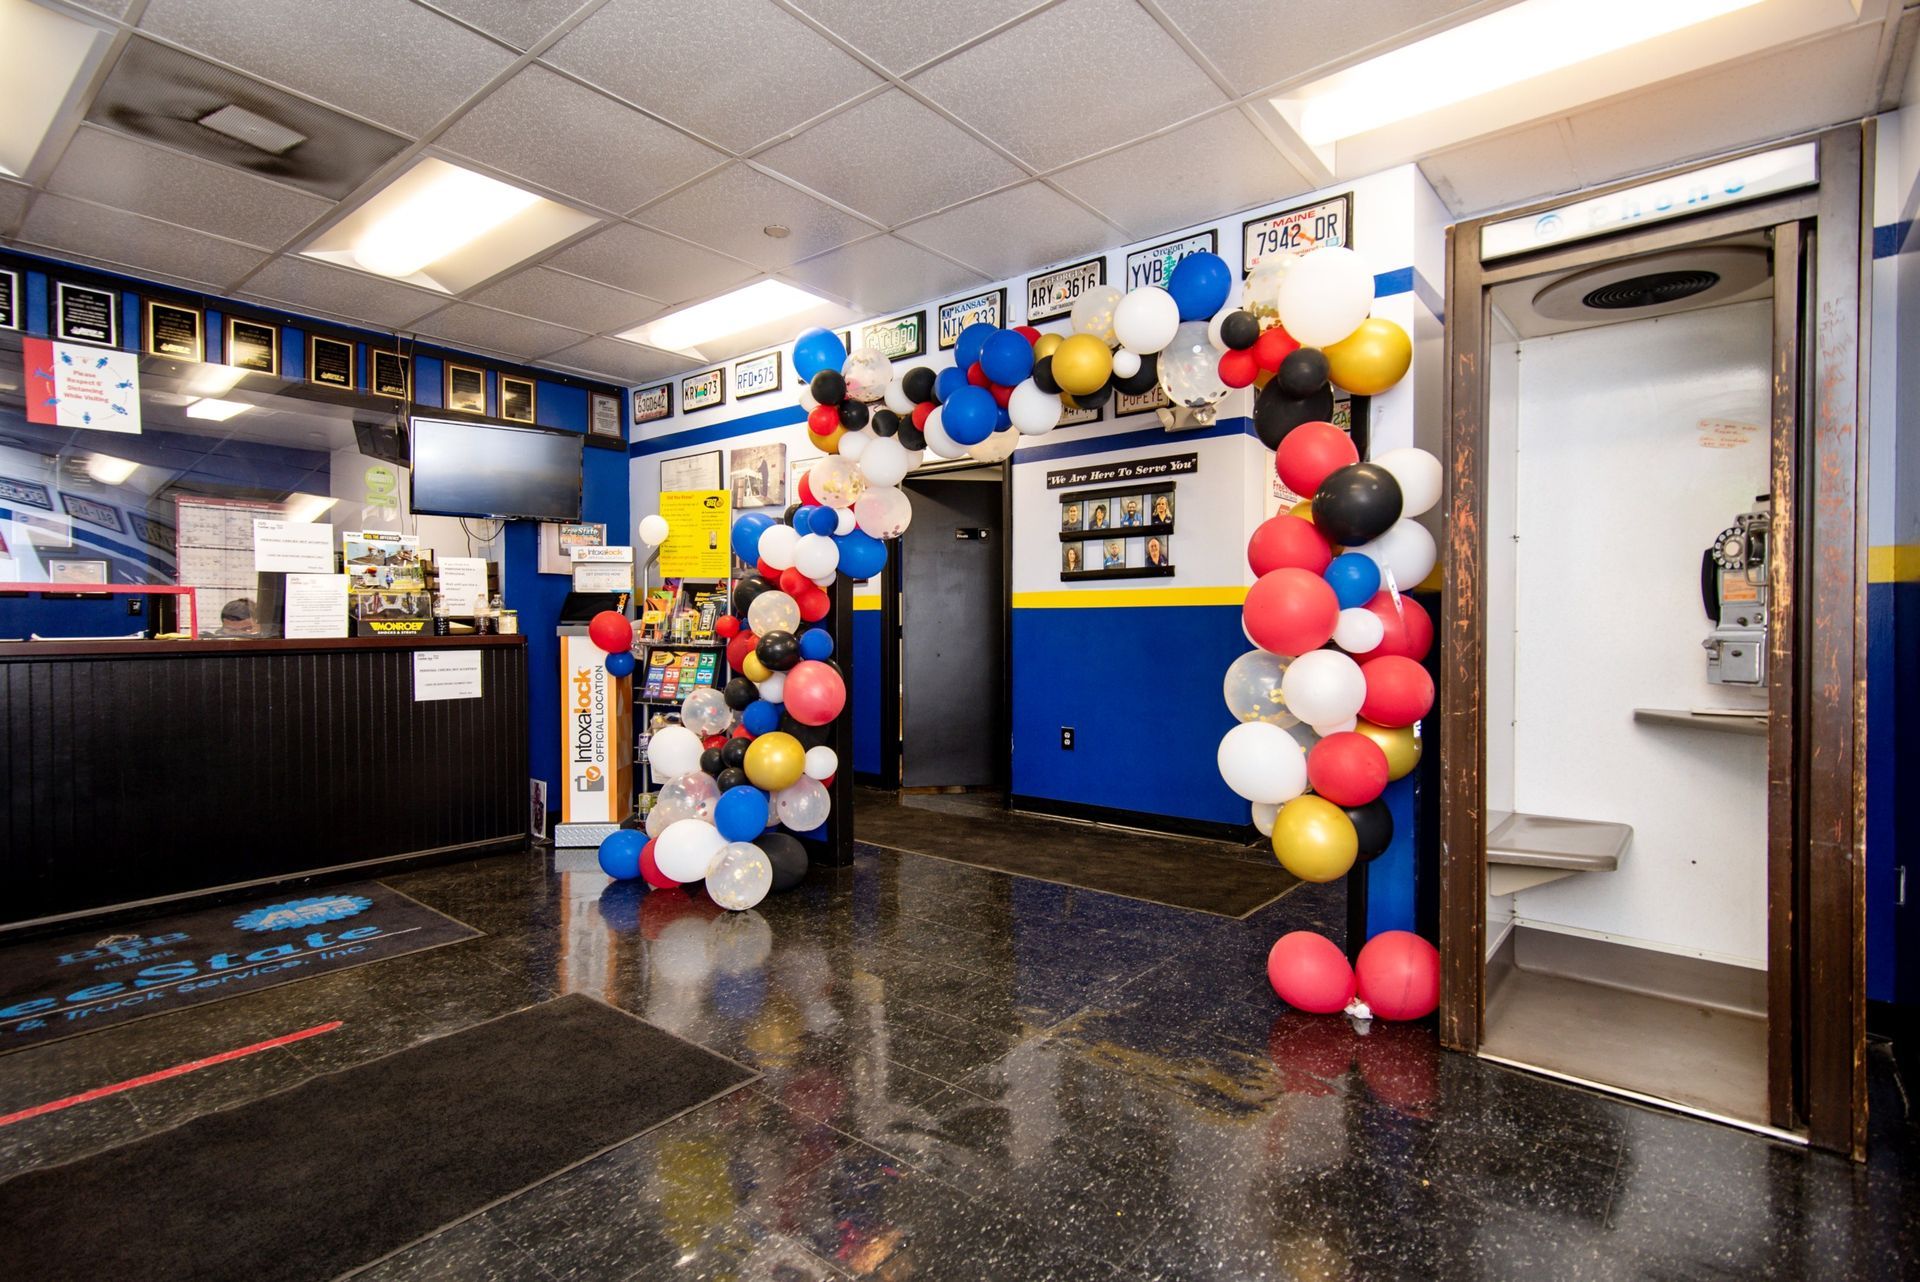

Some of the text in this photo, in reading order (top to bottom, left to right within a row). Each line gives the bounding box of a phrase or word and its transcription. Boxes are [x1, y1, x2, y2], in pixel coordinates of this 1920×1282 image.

[1272, 210, 1316, 228] MAINE
[1257, 213, 1338, 256] 7942 DR
[1152, 243, 1184, 257] Oregon
[1045, 270, 1086, 284] GEORGIA
[1132, 259, 1163, 288] YVB
[1031, 273, 1096, 308] ARY 3616
[955, 298, 987, 313] KANSAS
[67, 377, 95, 386] Respect
[73, 370, 96, 378] Please
[758, 366, 774, 385] 575
[64, 392, 109, 404] While Visiting
[67, 385, 104, 395] Distancing
[684, 380, 717, 401] KRY 873
[1068, 473, 1087, 483] Are
[1090, 471, 1115, 481] Here
[1117, 468, 1132, 478] To
[1135, 464, 1167, 475] Serve
[587, 548, 623, 556] Intoxalock
[370, 622, 424, 631] MONROE
[573, 667, 592, 763] Intoxalock
[595, 665, 605, 763] OFFICIAL LOCATION
[94, 950, 176, 971] MEMBER
[65, 991, 166, 1021] Truck
